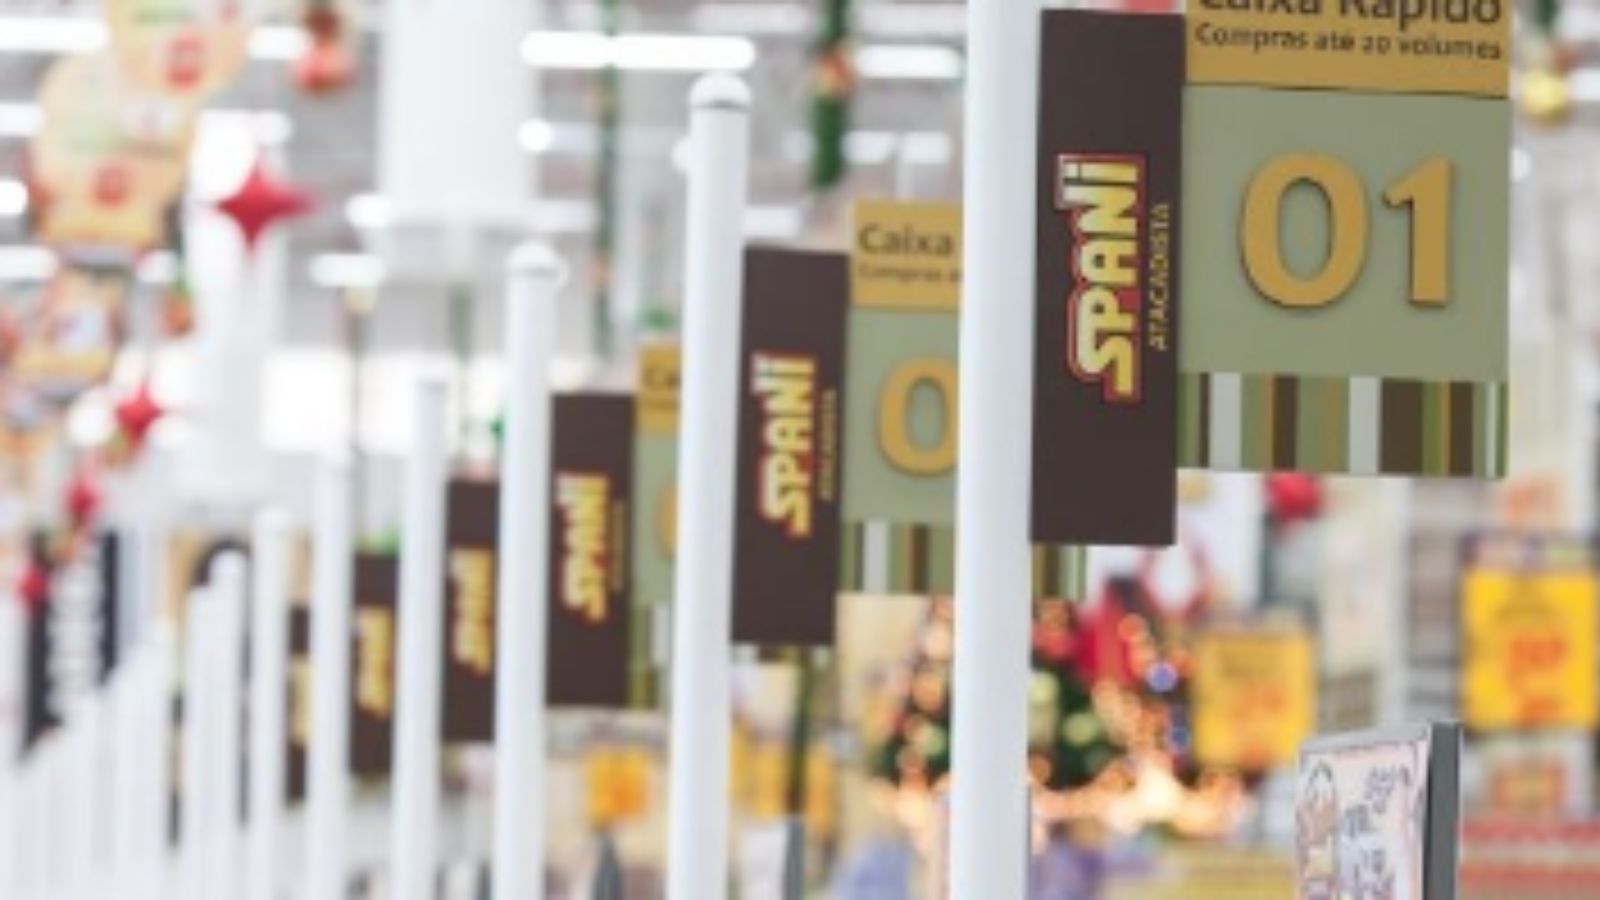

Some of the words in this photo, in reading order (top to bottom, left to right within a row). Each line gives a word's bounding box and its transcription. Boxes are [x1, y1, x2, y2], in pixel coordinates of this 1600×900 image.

[1194, 22, 1308, 54] Compras
[1400, 34, 1502, 60] volumes
[857, 221, 954, 257] Caixa
[1239, 152, 1455, 309] 01
[1148, 203, 1170, 352] ATACADISTA
